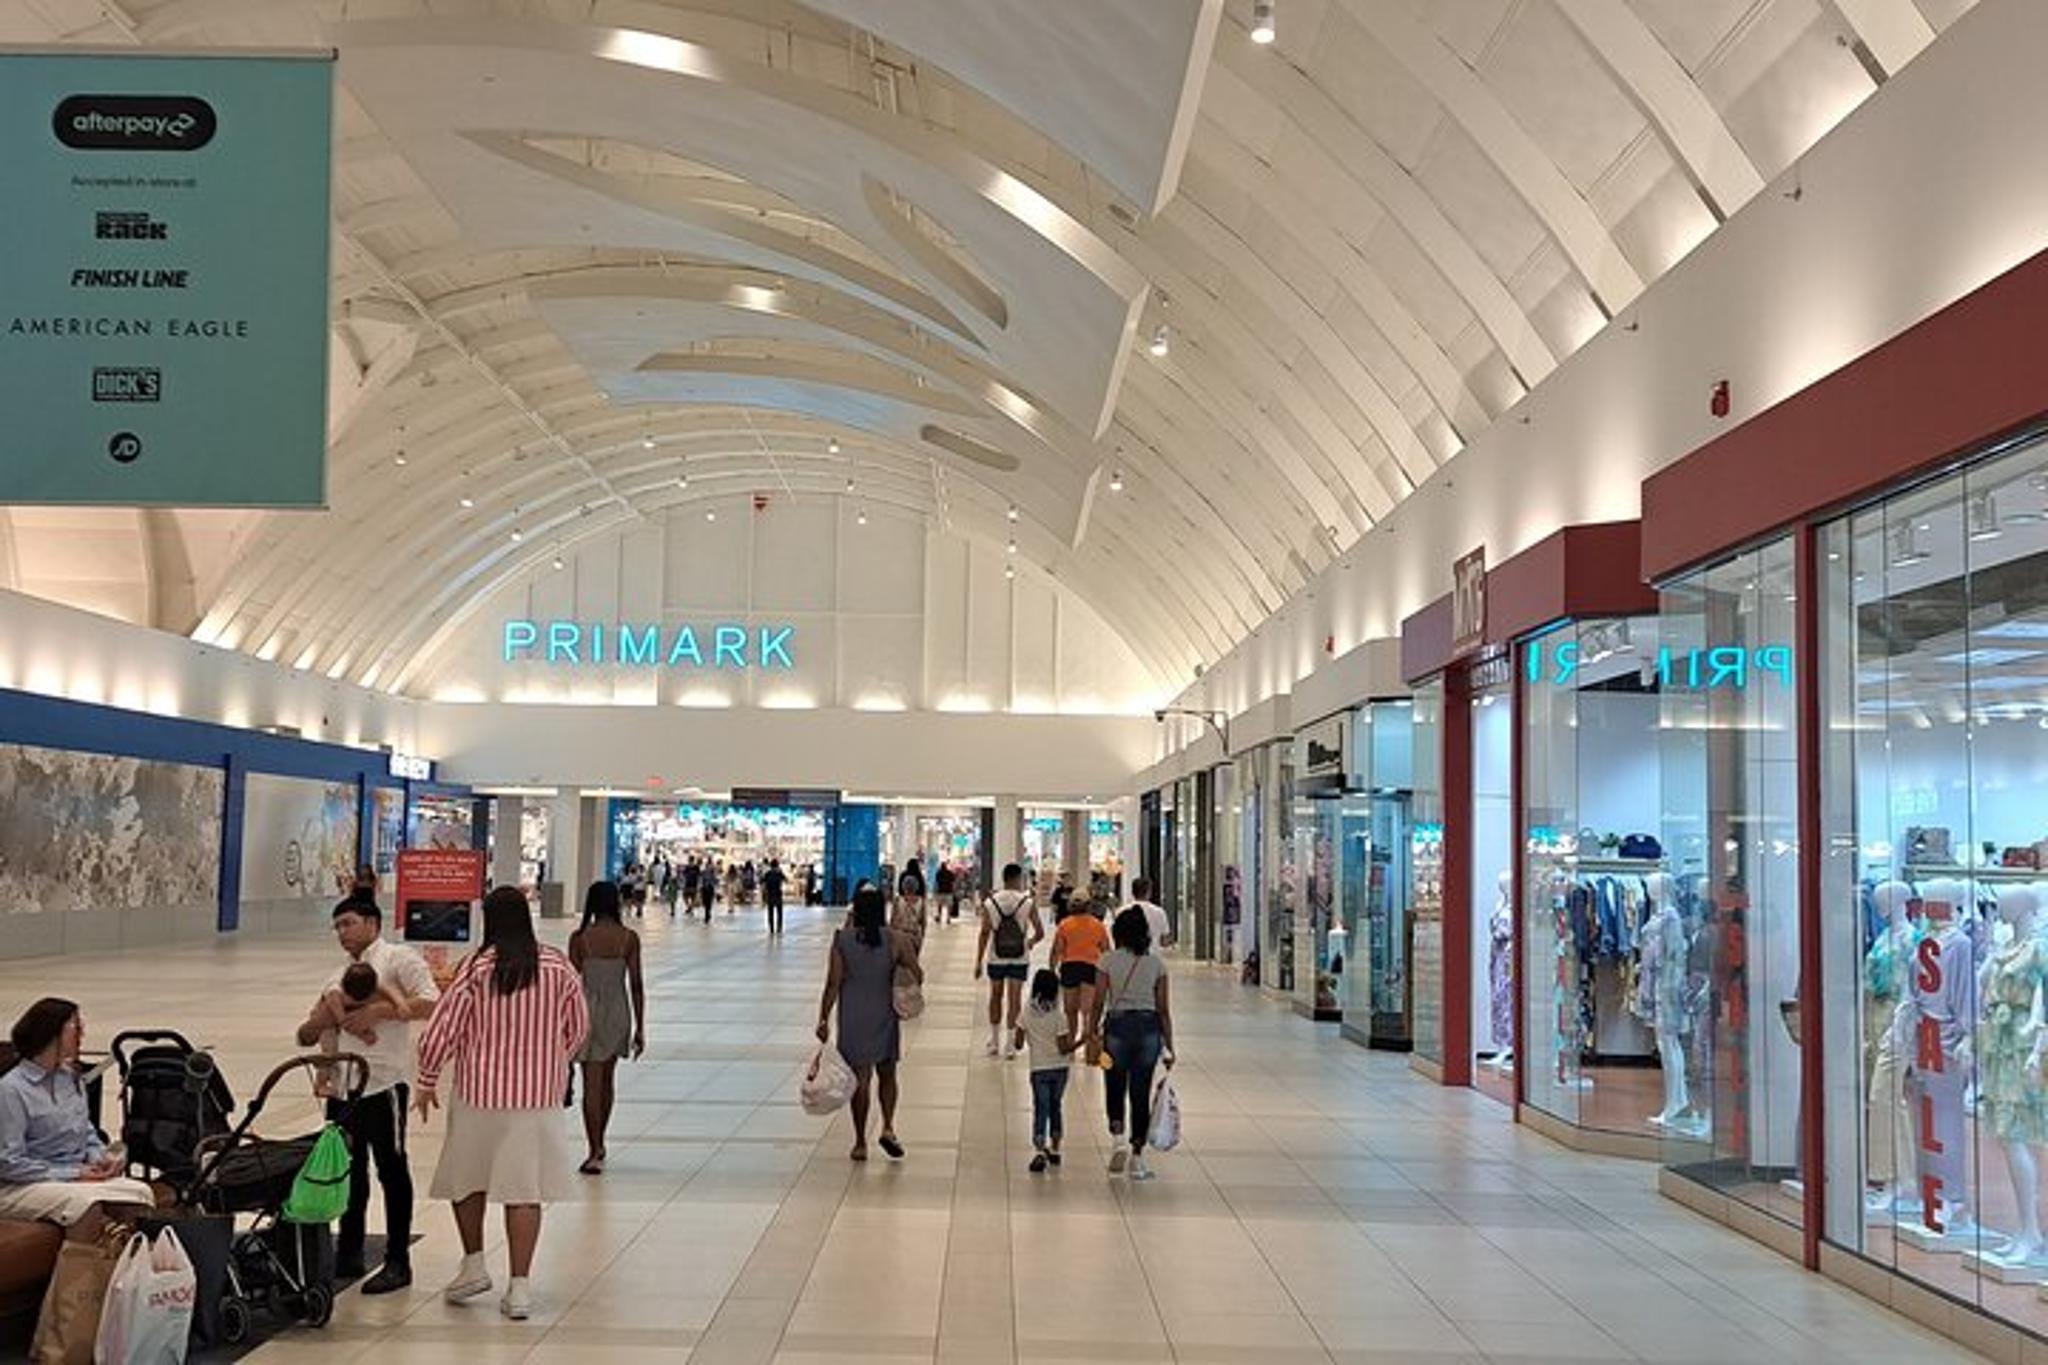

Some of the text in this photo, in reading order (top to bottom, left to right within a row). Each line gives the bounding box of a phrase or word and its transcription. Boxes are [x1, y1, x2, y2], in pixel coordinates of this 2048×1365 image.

[73, 111, 168, 136] afterpay
[71, 268, 190, 289] FINISH LINE
[9, 318, 249, 338] AMERICAN EAGLE
[95, 373, 159, 395] DICK'S
[113, 439, 138, 457] JD
[503, 620, 795, 668] PRIMARK
[1917, 937, 1944, 1235] SALE
